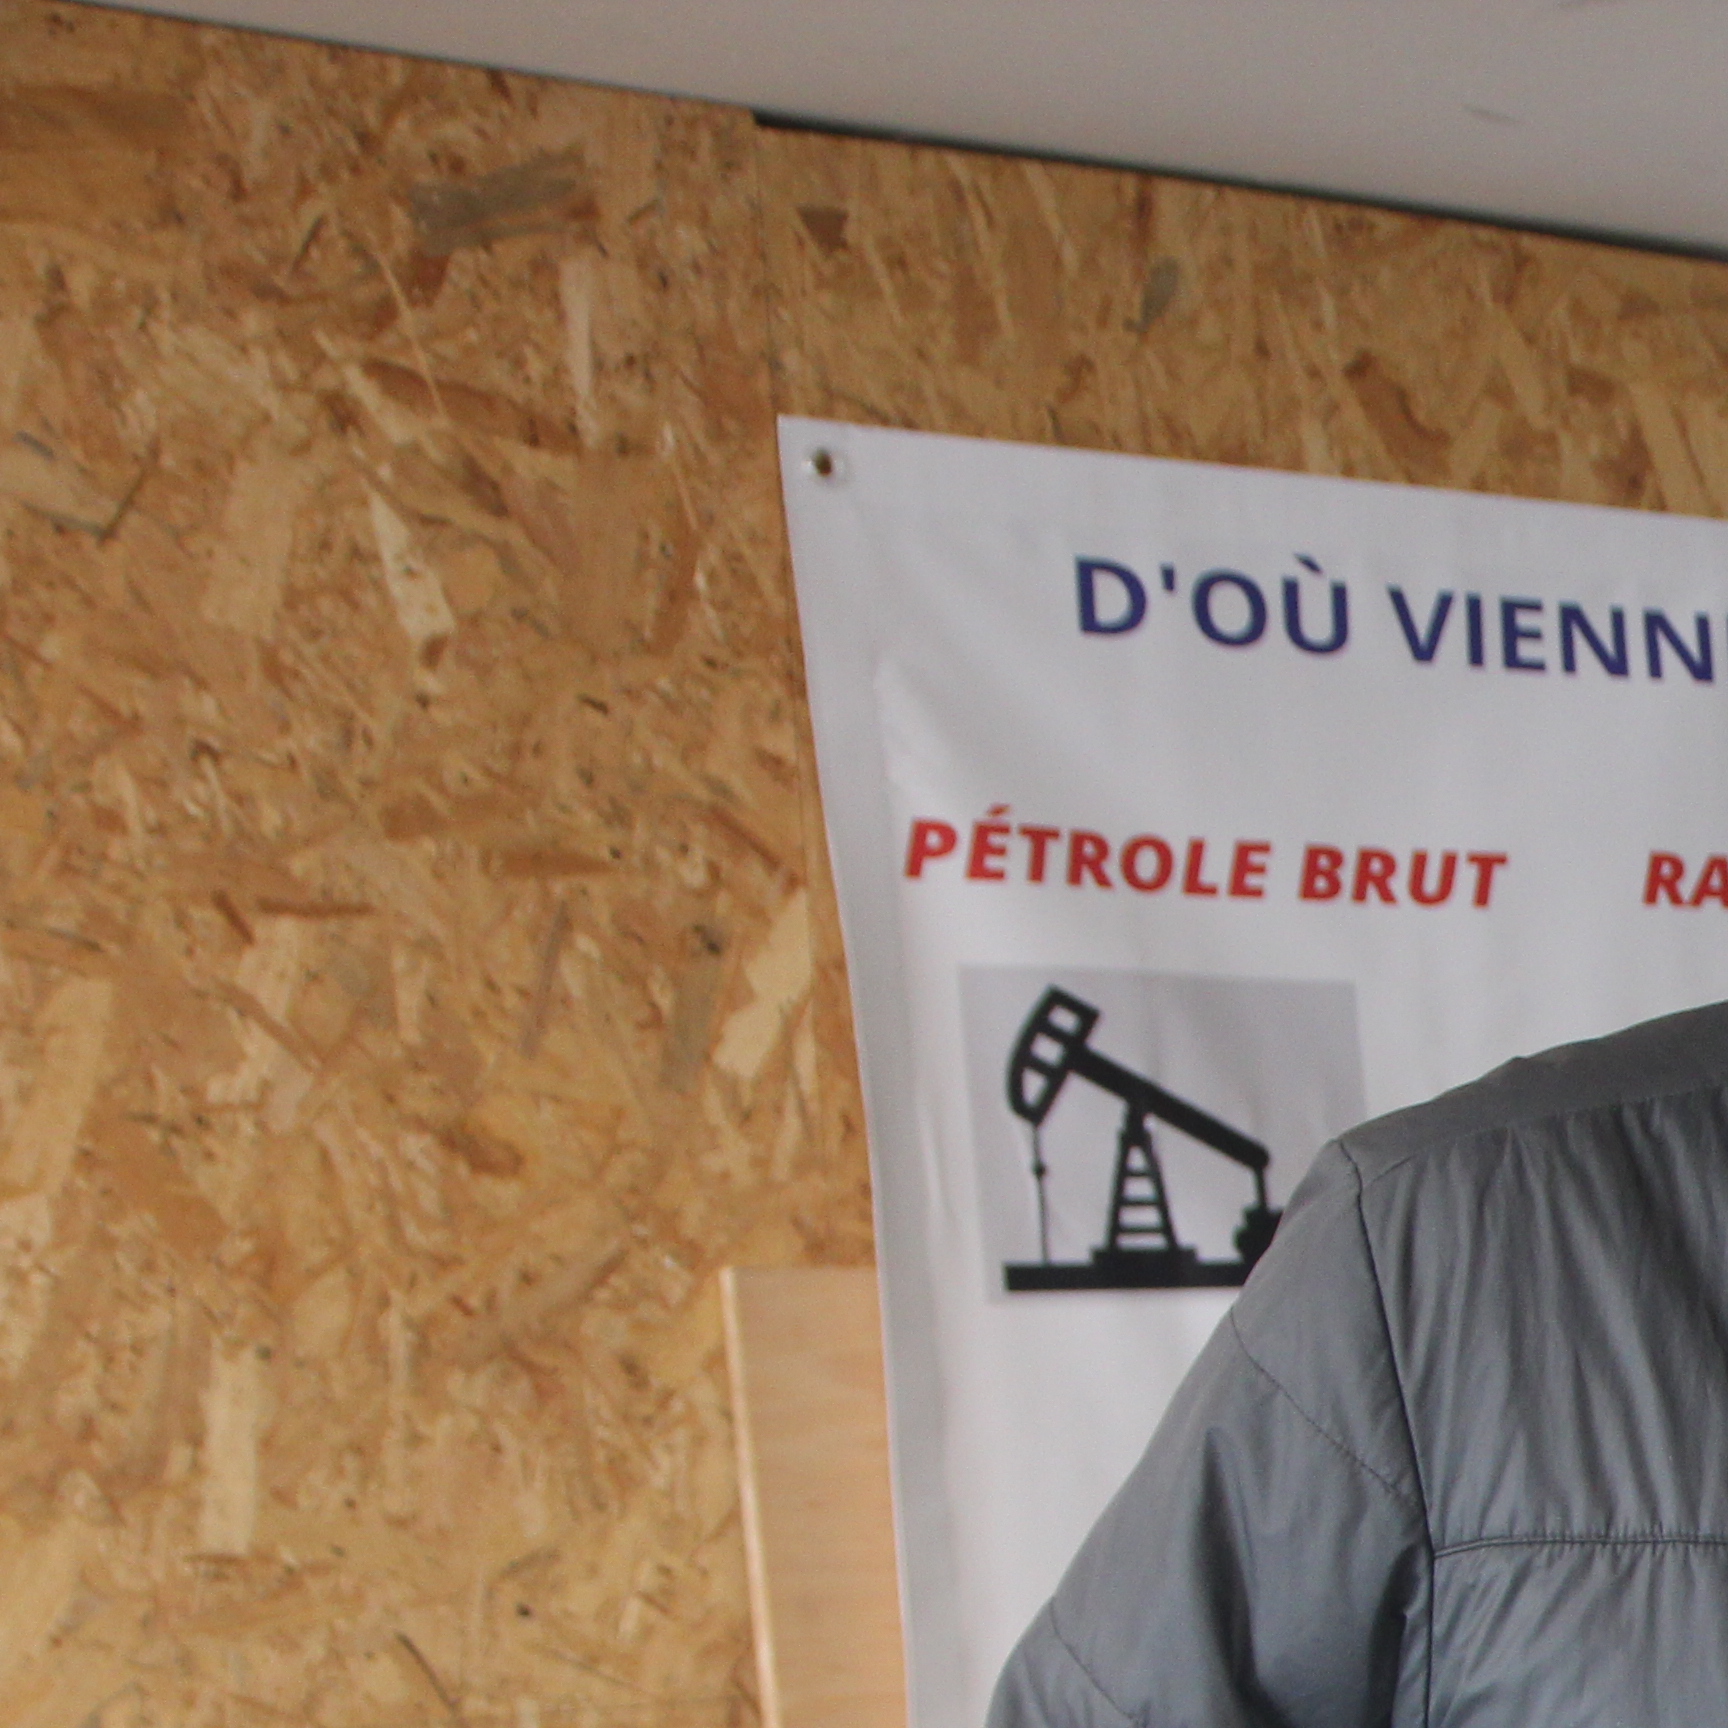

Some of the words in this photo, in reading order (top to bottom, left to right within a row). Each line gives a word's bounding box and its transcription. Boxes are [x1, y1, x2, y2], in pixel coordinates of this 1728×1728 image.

[1073, 552, 1351, 657] D'OÙ
[904, 803, 1273, 898] PÉTROLE
[1298, 842, 1508, 908] BRUT
